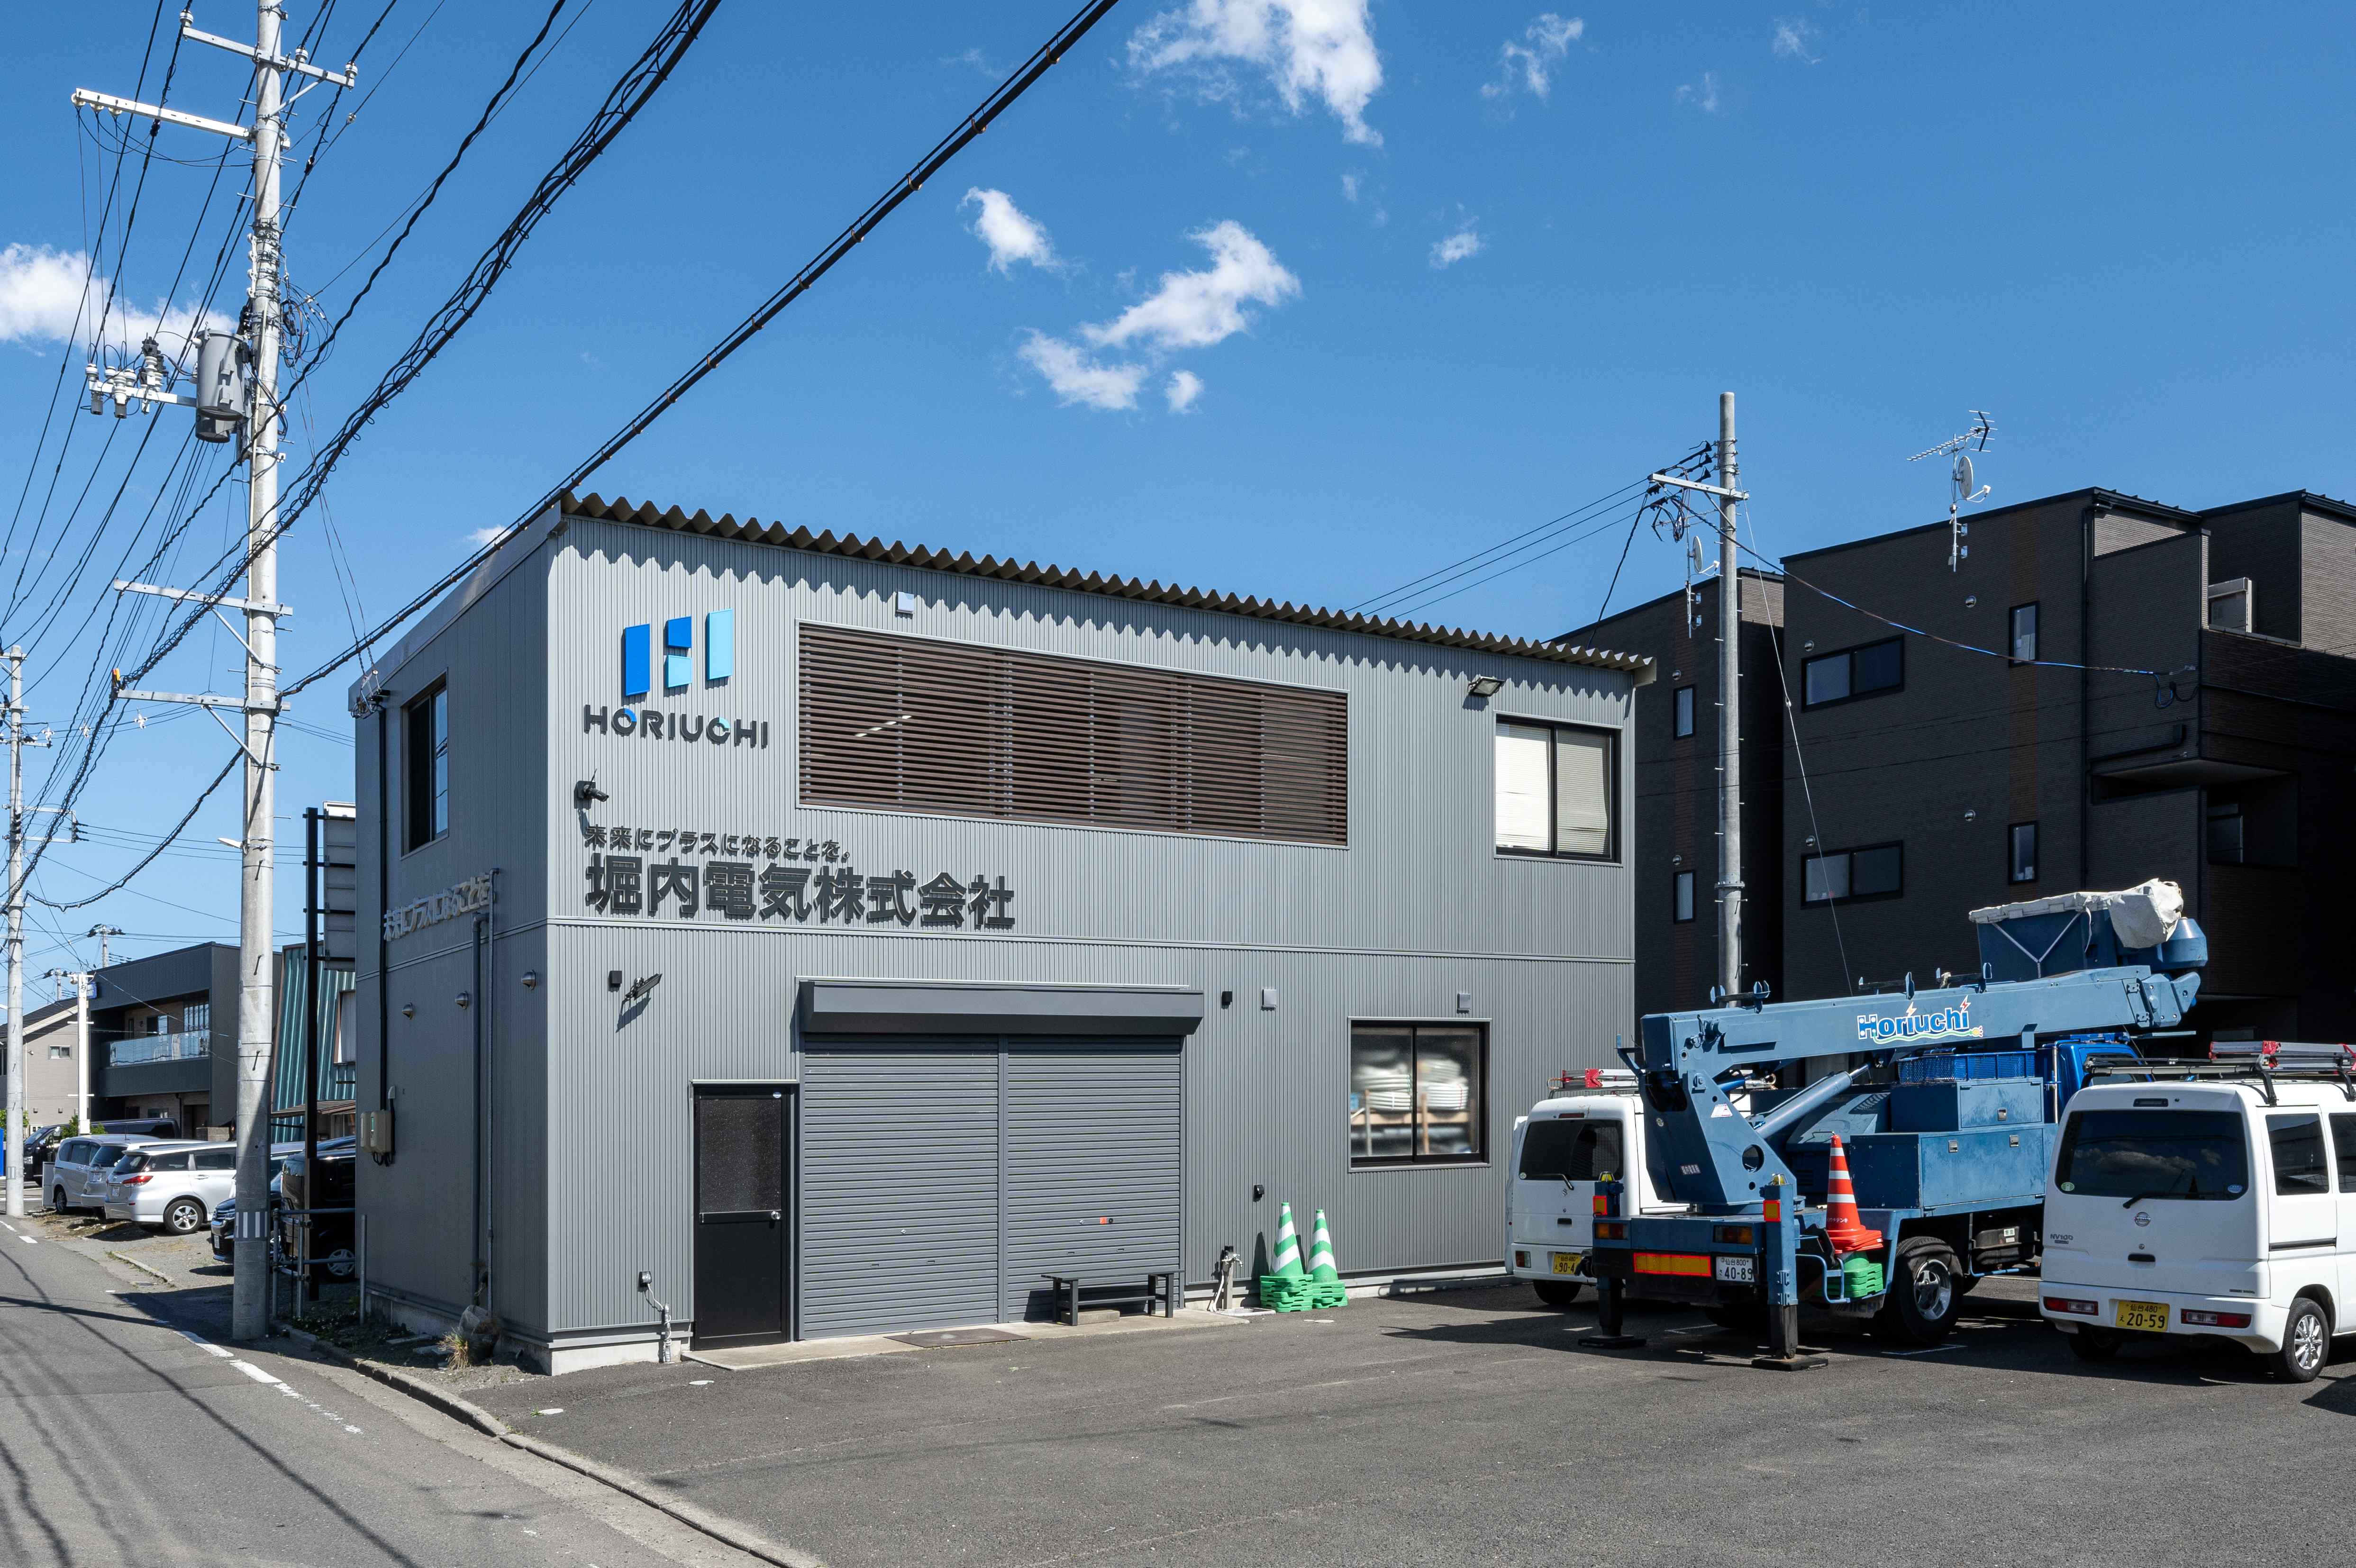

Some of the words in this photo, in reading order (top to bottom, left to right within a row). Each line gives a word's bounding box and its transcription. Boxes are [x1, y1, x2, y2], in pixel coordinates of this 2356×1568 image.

[584, 704, 768, 747] HORIUCHI
[585, 824, 850, 860] 未来にプラスになることを。
[586, 853, 1015, 926] 堀内電気株式会社
[1857, 996, 1971, 1040] Horiuchi
[1559, 1262, 1575, 1272] 90-4
[1725, 1267, 1753, 1280] 40-89
[2127, 1313, 2165, 1329] 20-59
